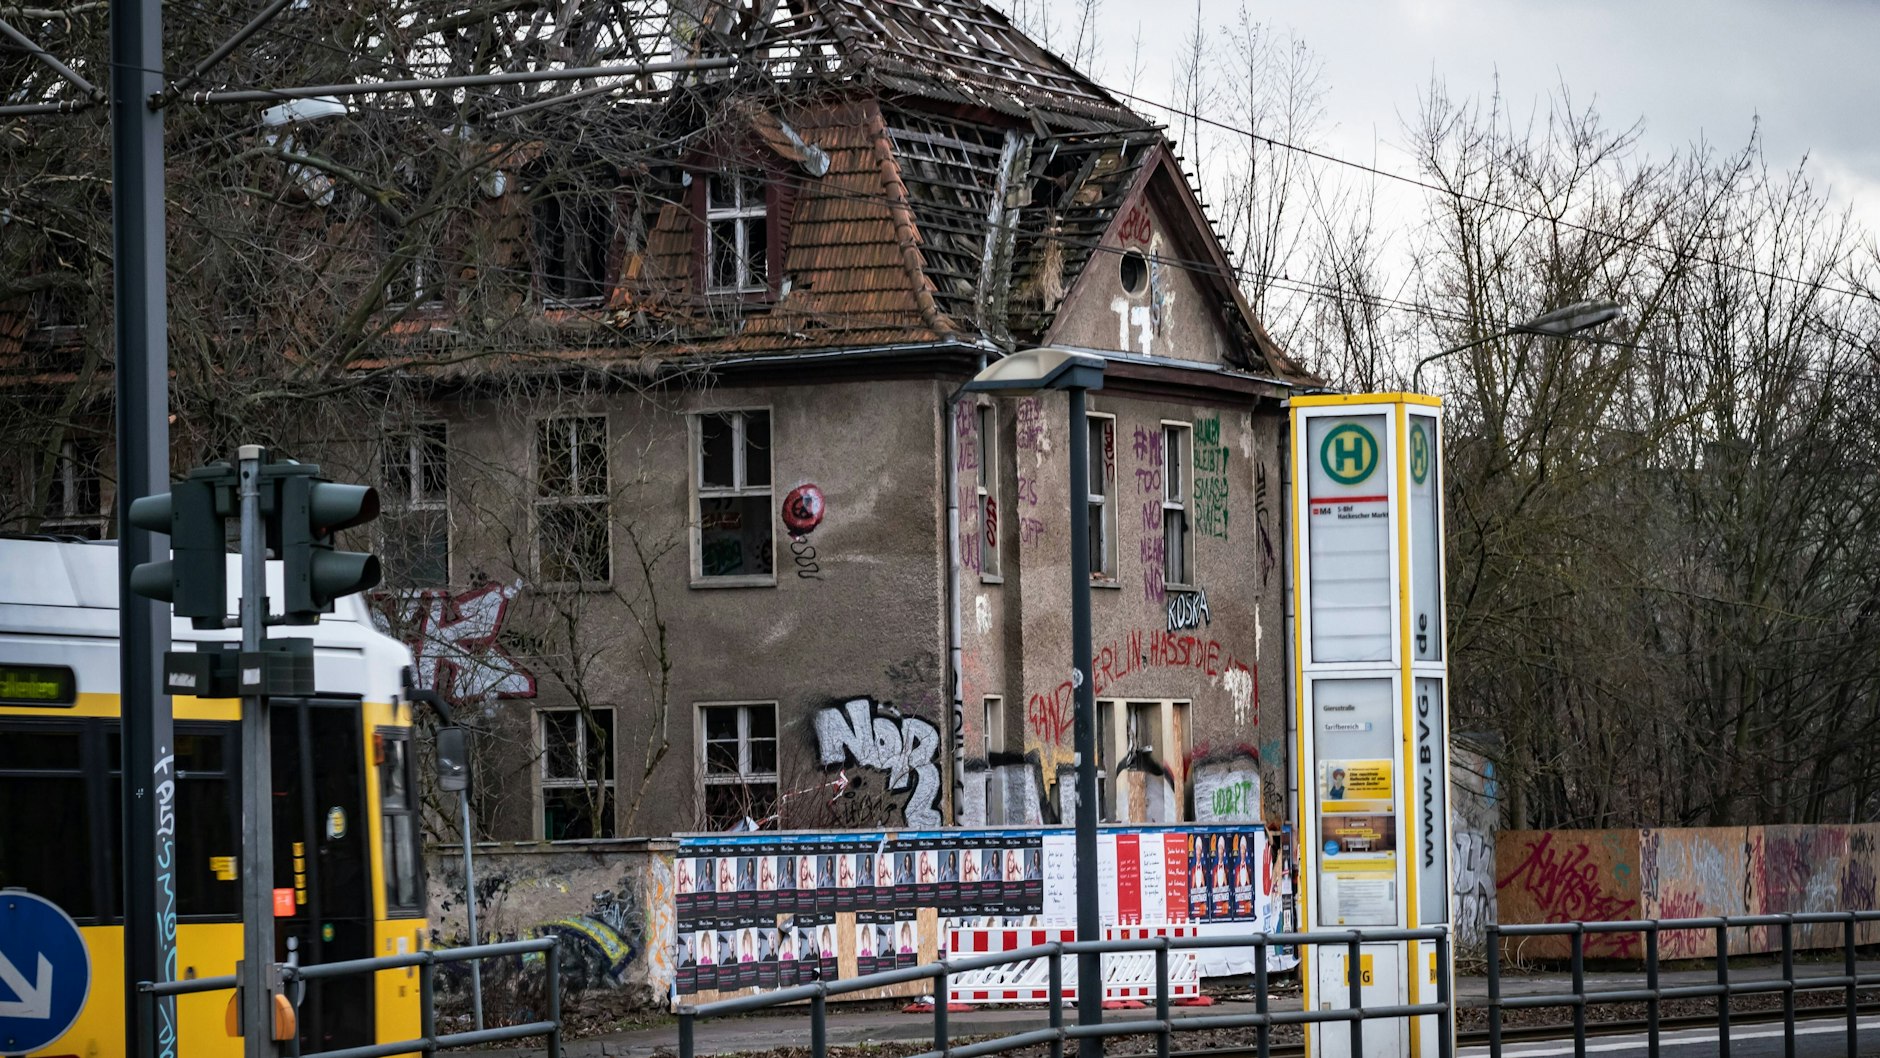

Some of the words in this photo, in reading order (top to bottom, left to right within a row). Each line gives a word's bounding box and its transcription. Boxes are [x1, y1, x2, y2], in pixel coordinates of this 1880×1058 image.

[1135, 468, 1162, 495] TOO
[1143, 500, 1162, 532] NO
[1320, 507, 1331, 515] M4
[1144, 568, 1165, 604] NO
[1167, 588, 1210, 633] KOSKA
[1029, 681, 1074, 747] GANZ
[1092, 628, 1142, 697] ERLIN
[1195, 636, 1231, 676] DIE
